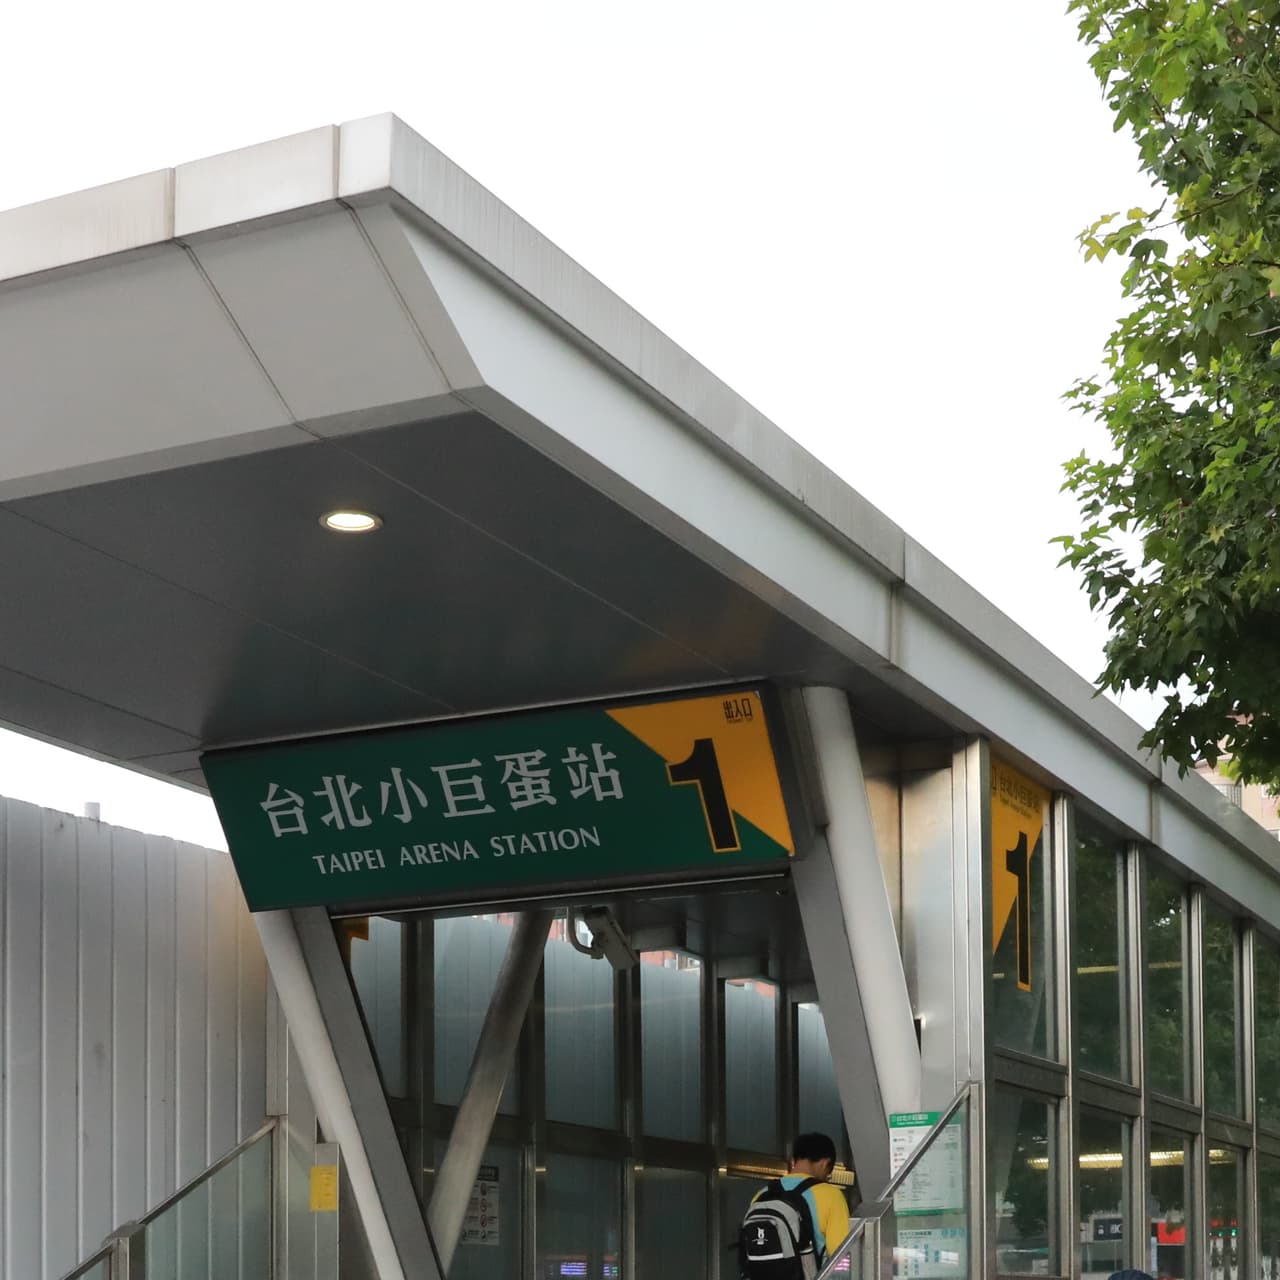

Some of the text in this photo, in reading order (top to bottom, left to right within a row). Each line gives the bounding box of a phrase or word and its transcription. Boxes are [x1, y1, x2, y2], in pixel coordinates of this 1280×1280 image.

[259, 743, 625, 838] 台北小巨蛋站
[666, 737, 741, 852] 1
[312, 826, 601, 875] TAIPEI ARENA STATION
